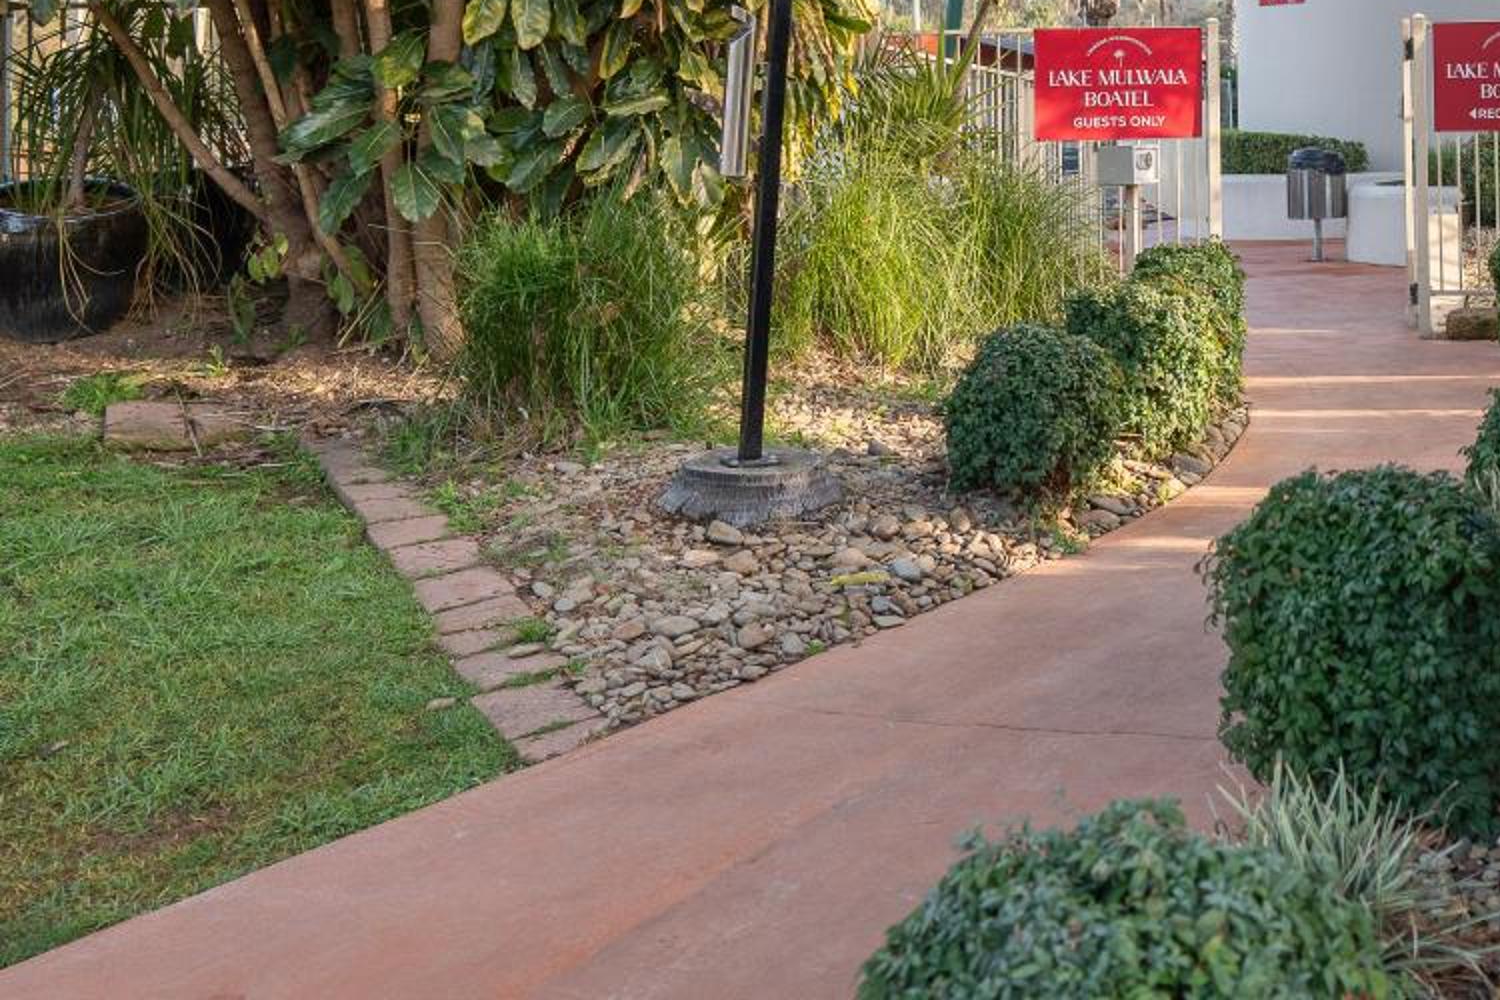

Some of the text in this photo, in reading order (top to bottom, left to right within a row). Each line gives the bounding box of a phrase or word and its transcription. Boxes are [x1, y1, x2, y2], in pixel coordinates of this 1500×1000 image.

[1049, 68, 1188, 87] LAKE MULWALA
[1446, 62, 1489, 79] LAKE
[1084, 91, 1154, 107] BOATEL
[1073, 115, 1166, 129] GUESTS ONLY
